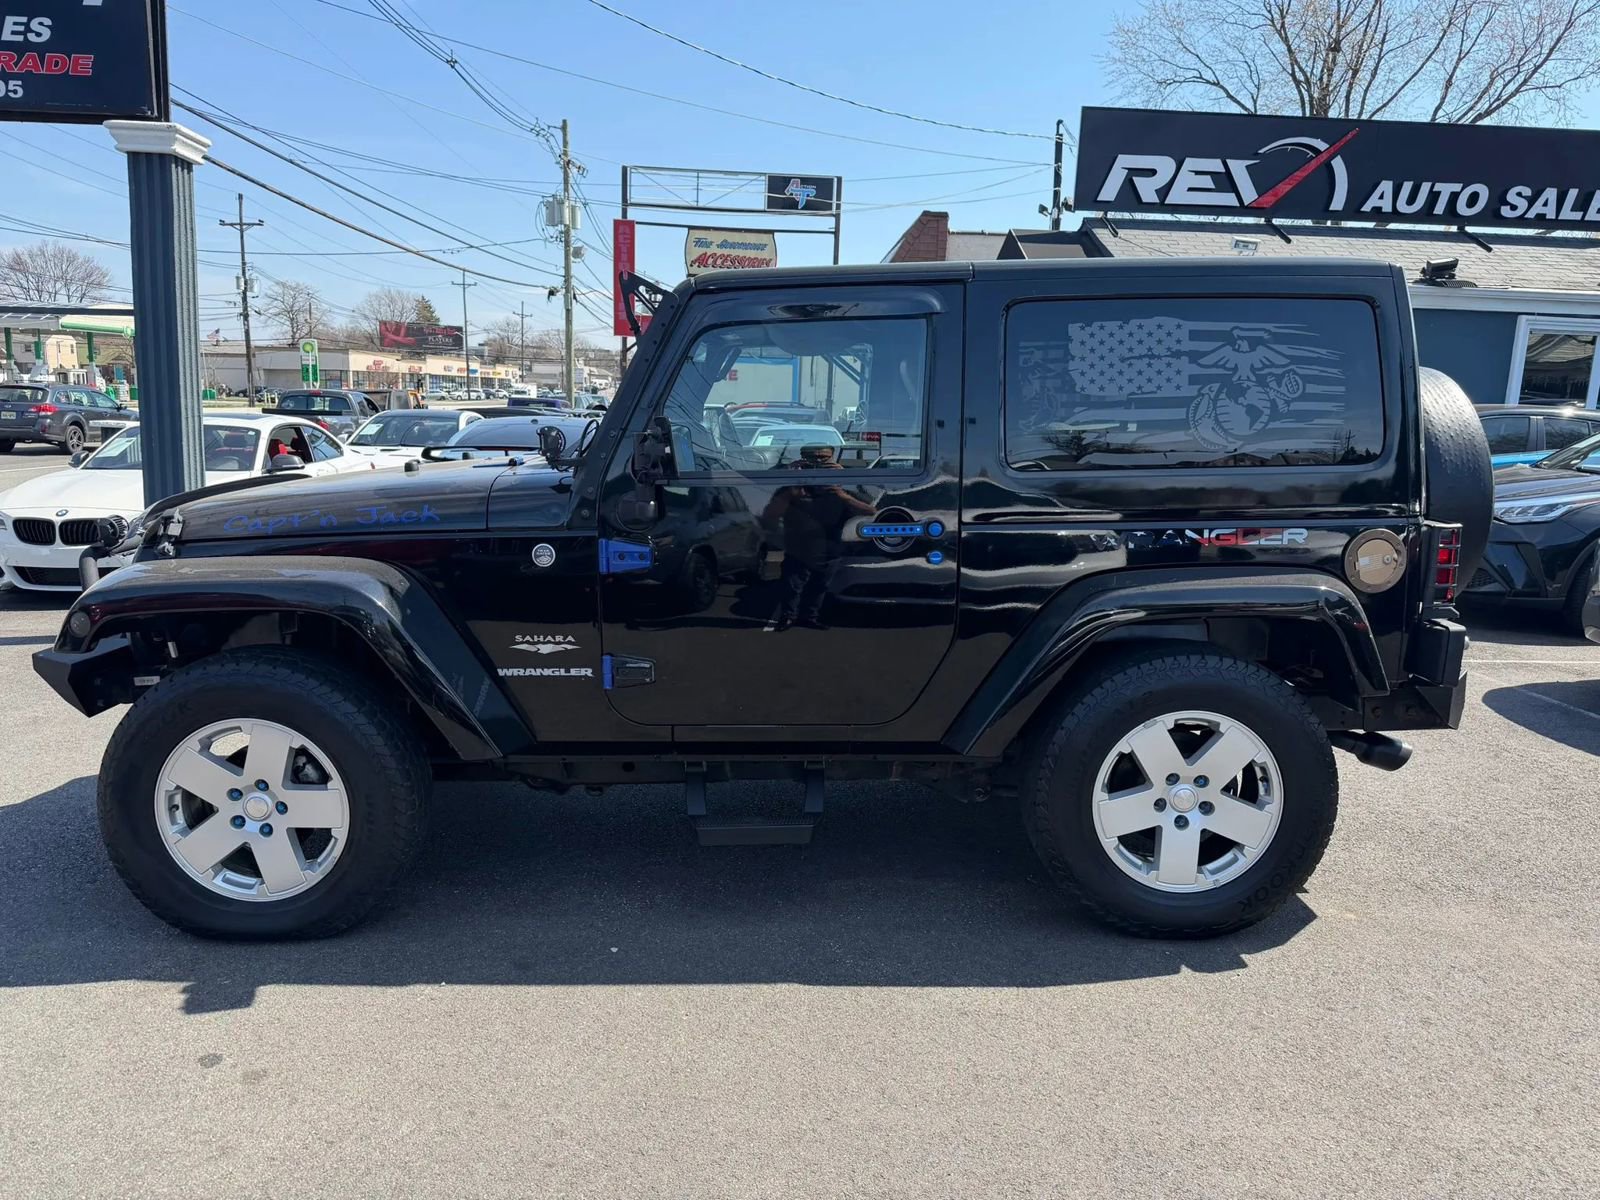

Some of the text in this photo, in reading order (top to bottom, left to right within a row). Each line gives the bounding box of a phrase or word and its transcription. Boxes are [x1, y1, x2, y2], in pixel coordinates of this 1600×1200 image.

[1361, 180, 1490, 218] AUTO
[355, 504, 441, 527] Jack
[514, 634, 576, 643] SAHARA
[496, 667, 594, 678] WRANGLER
